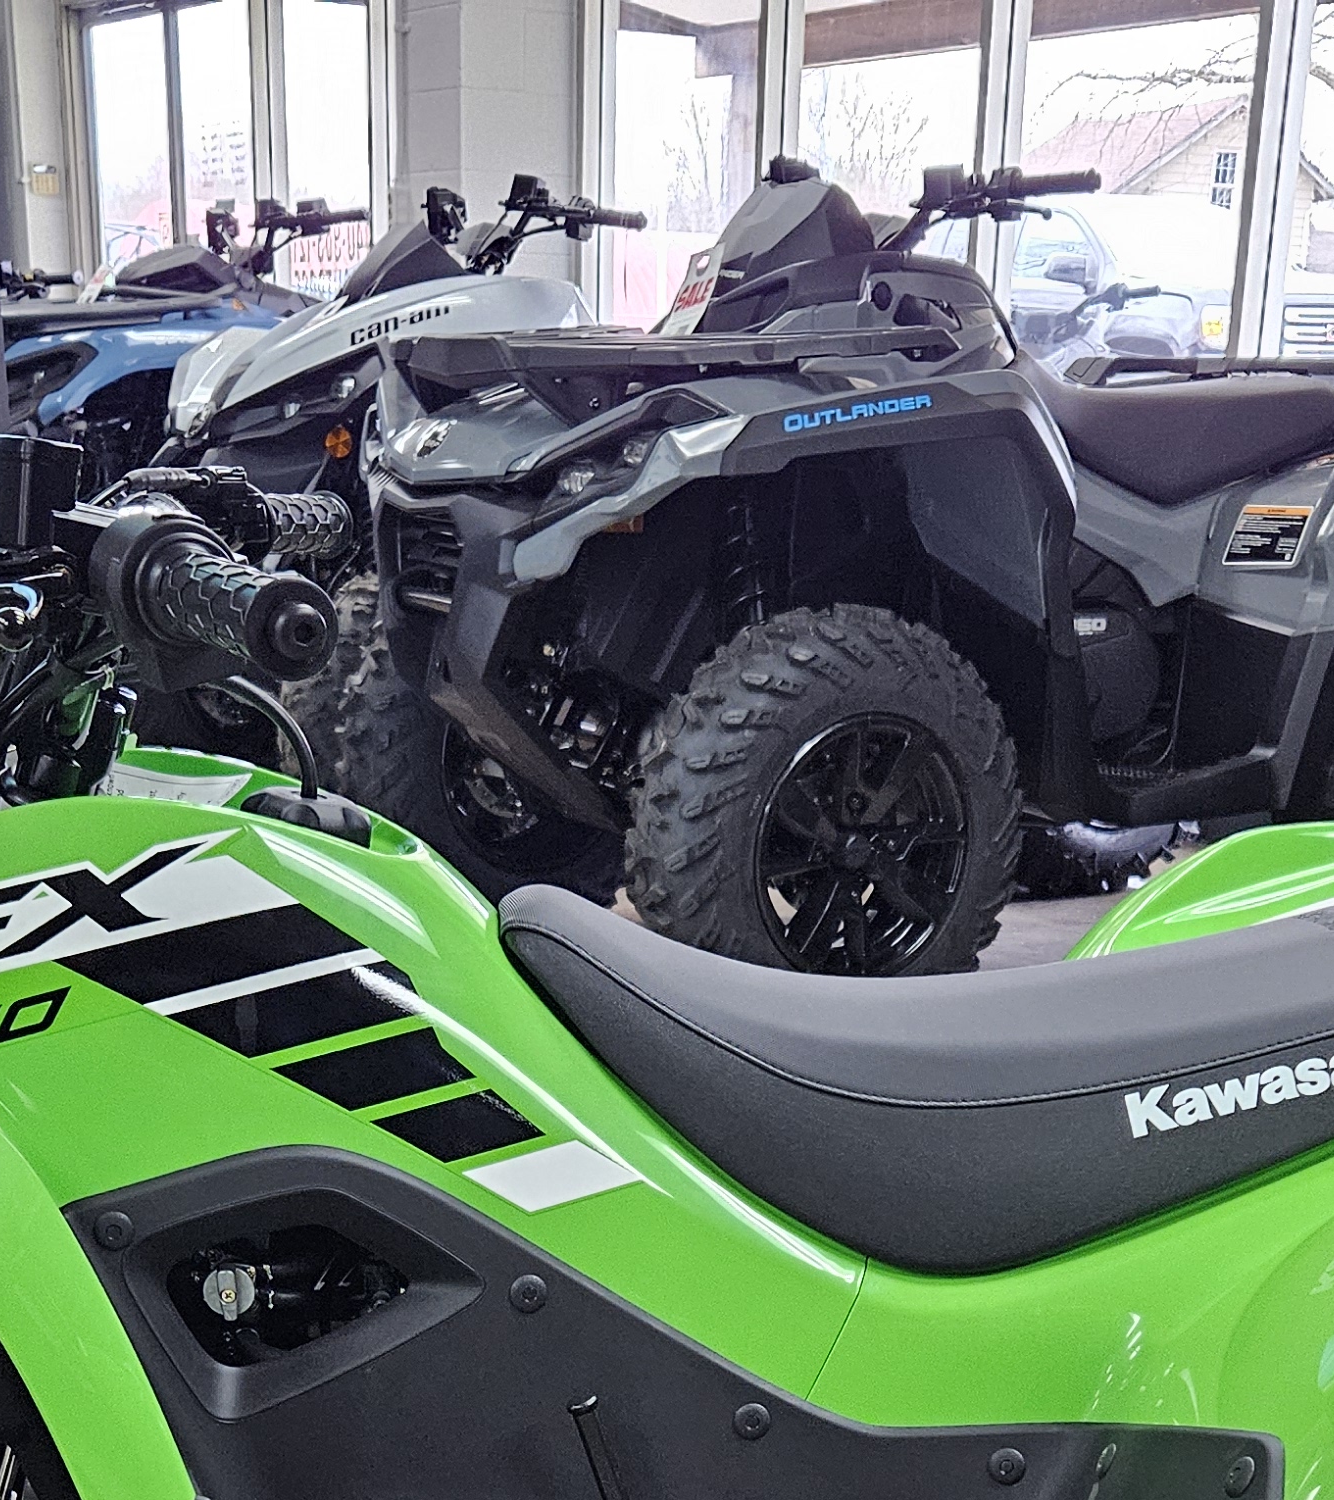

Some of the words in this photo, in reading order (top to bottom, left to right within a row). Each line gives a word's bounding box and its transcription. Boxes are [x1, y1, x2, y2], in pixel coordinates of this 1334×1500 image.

[674, 277, 715, 313] SALE
[350, 305, 450, 346] can-am
[783, 394, 933, 433] OUTLANDER
[1073, 618, 1107, 632] 50
